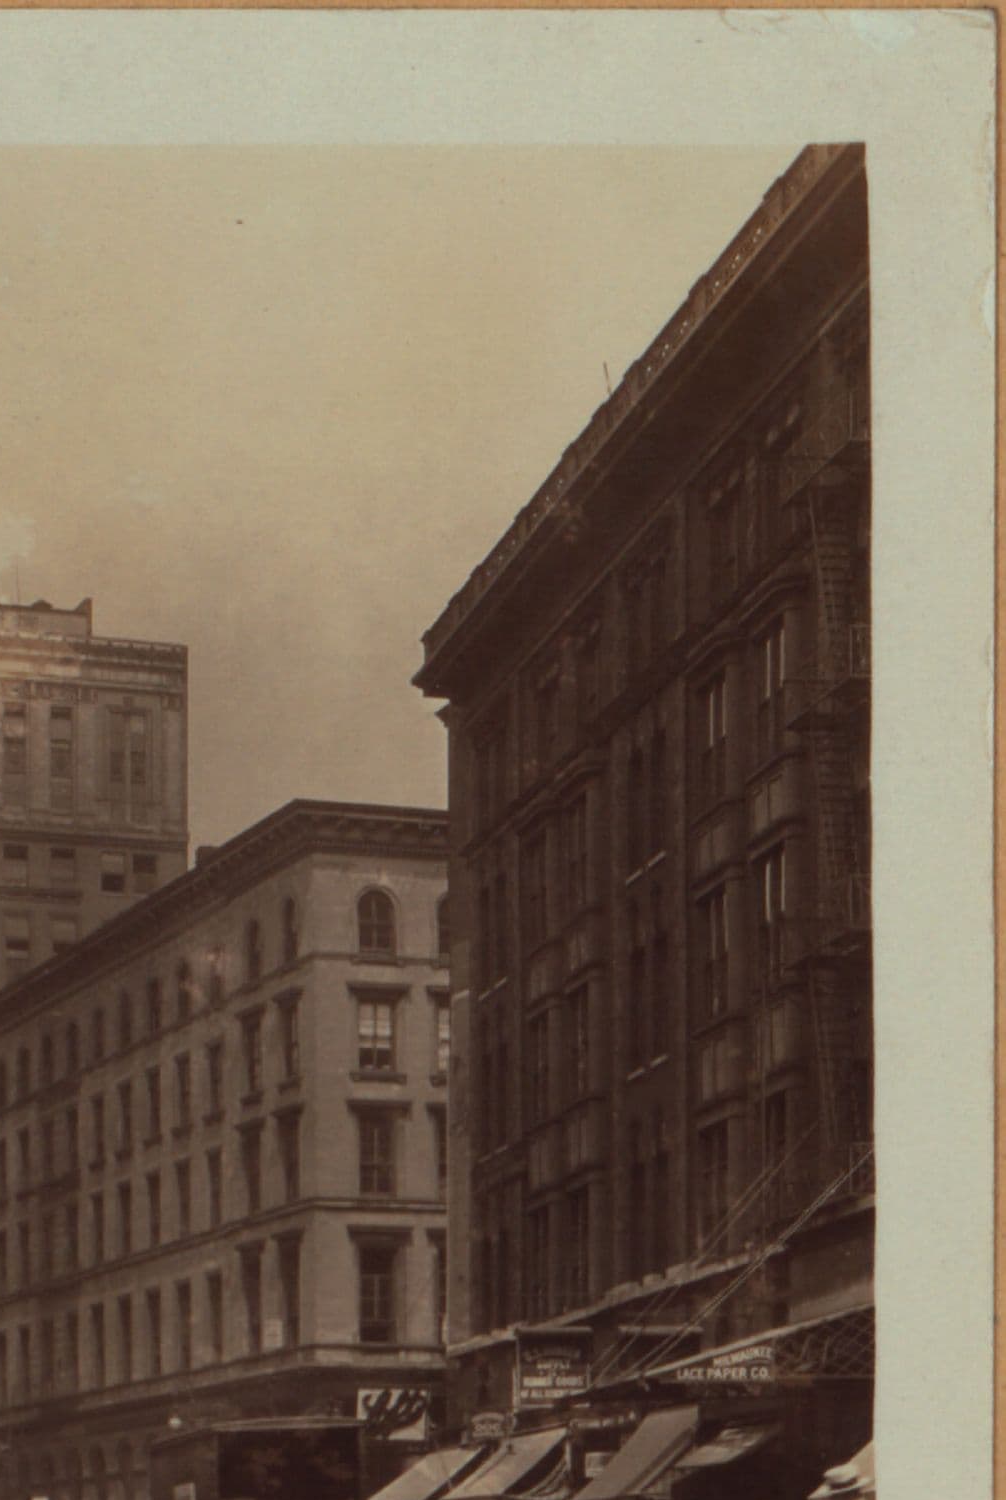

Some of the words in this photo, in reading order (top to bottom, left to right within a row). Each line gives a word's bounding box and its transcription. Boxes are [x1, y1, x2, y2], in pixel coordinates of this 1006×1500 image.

[713, 1346, 772, 1368] MILWAUKEE
[676, 1368, 705, 1381] LACE
[706, 1367, 747, 1380] PAPER
[750, 1367, 771, 1379] CO.
